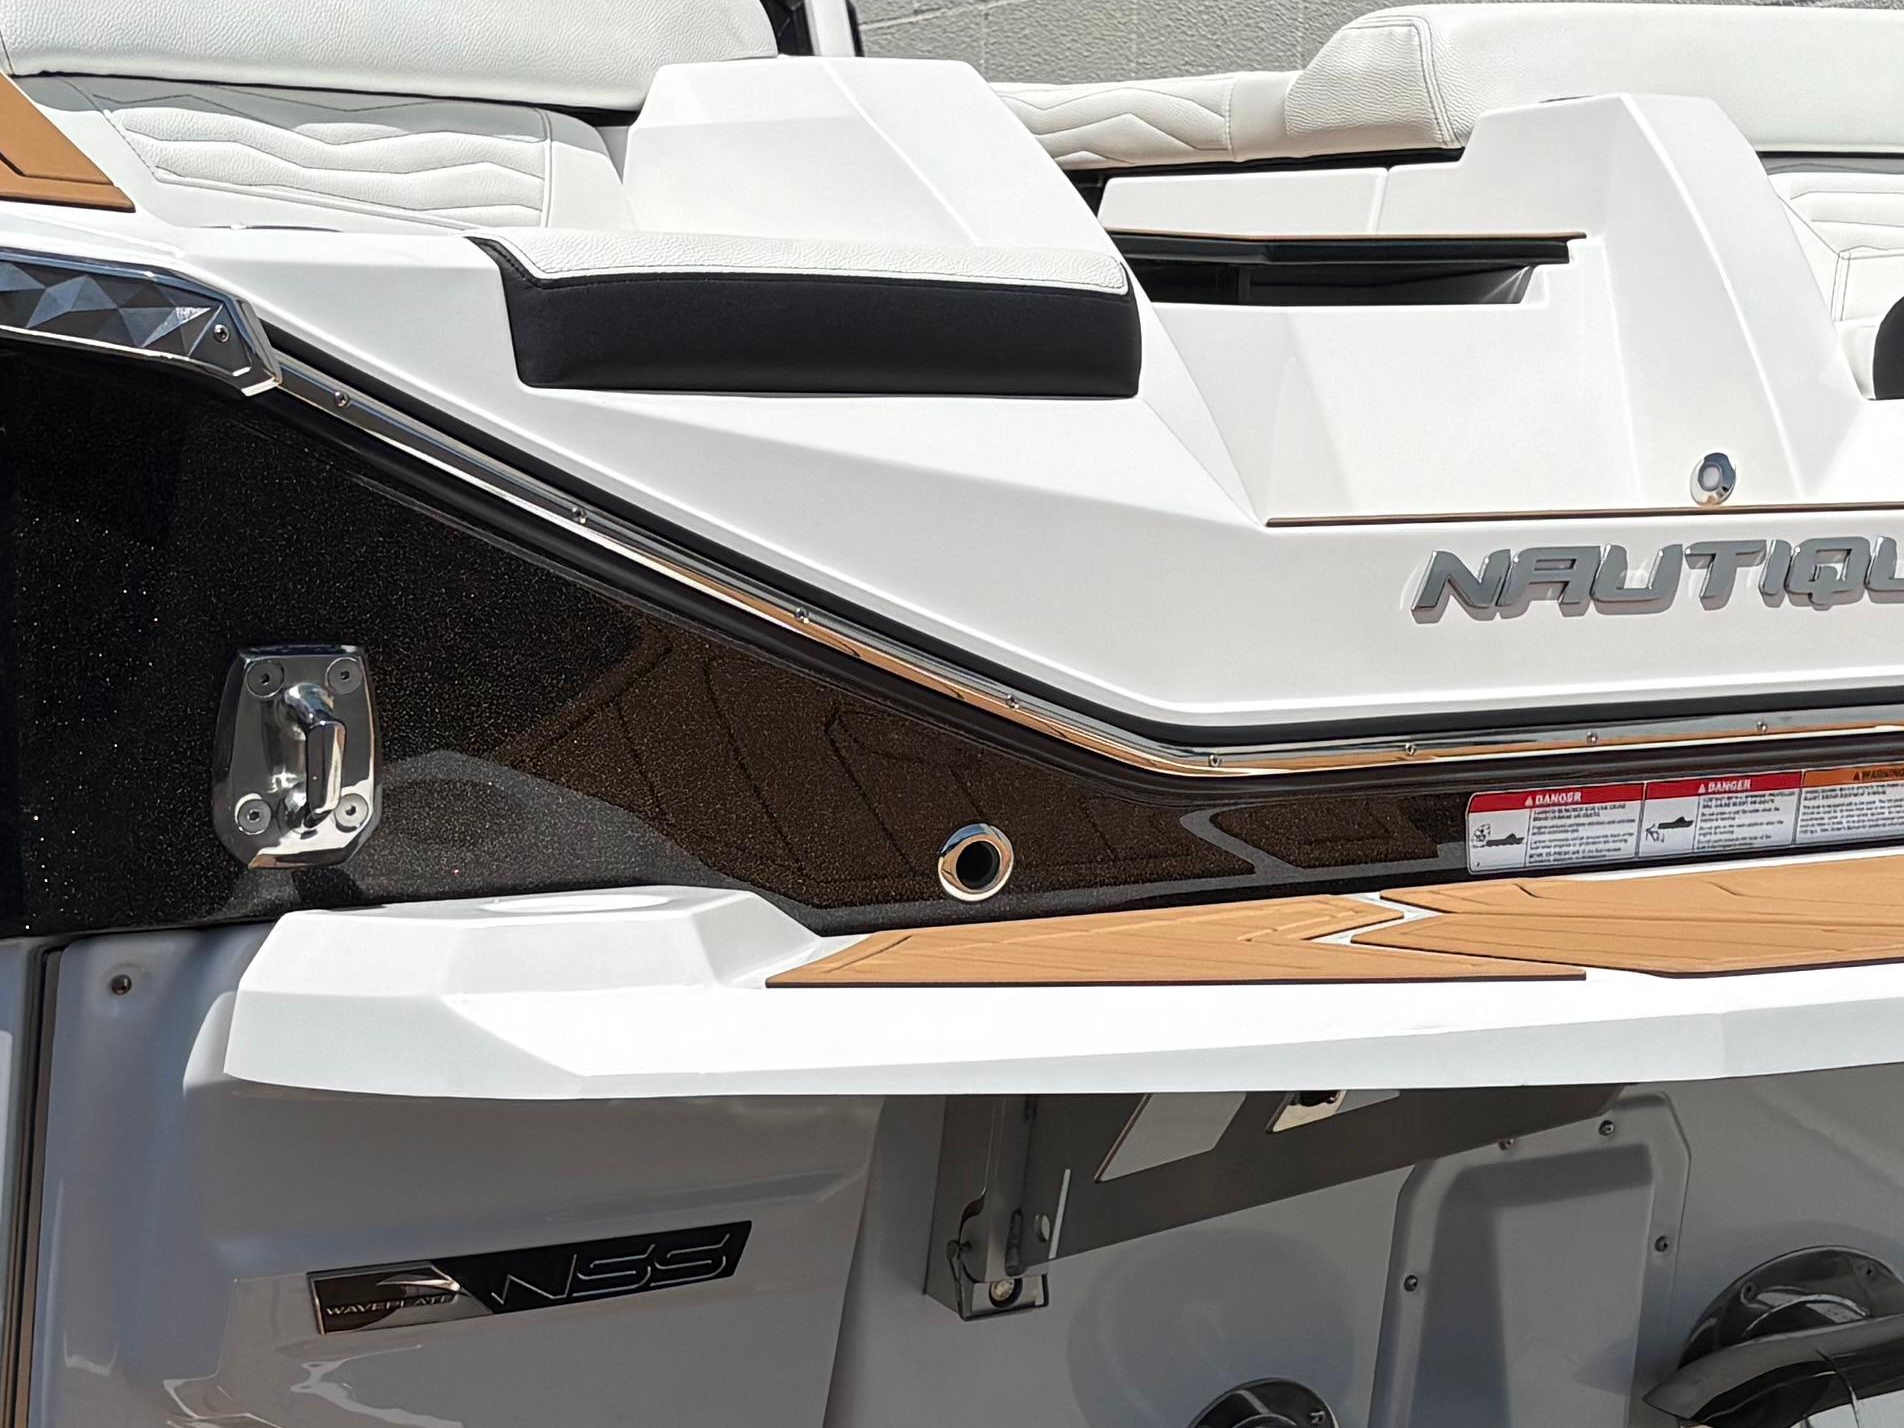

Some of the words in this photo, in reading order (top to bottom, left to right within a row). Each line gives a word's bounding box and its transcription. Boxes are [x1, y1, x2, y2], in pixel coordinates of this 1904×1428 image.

[1707, 779, 1752, 793] DANGER
[1535, 792, 1582, 805] DANGER
[490, 1233, 731, 1306] NSS
